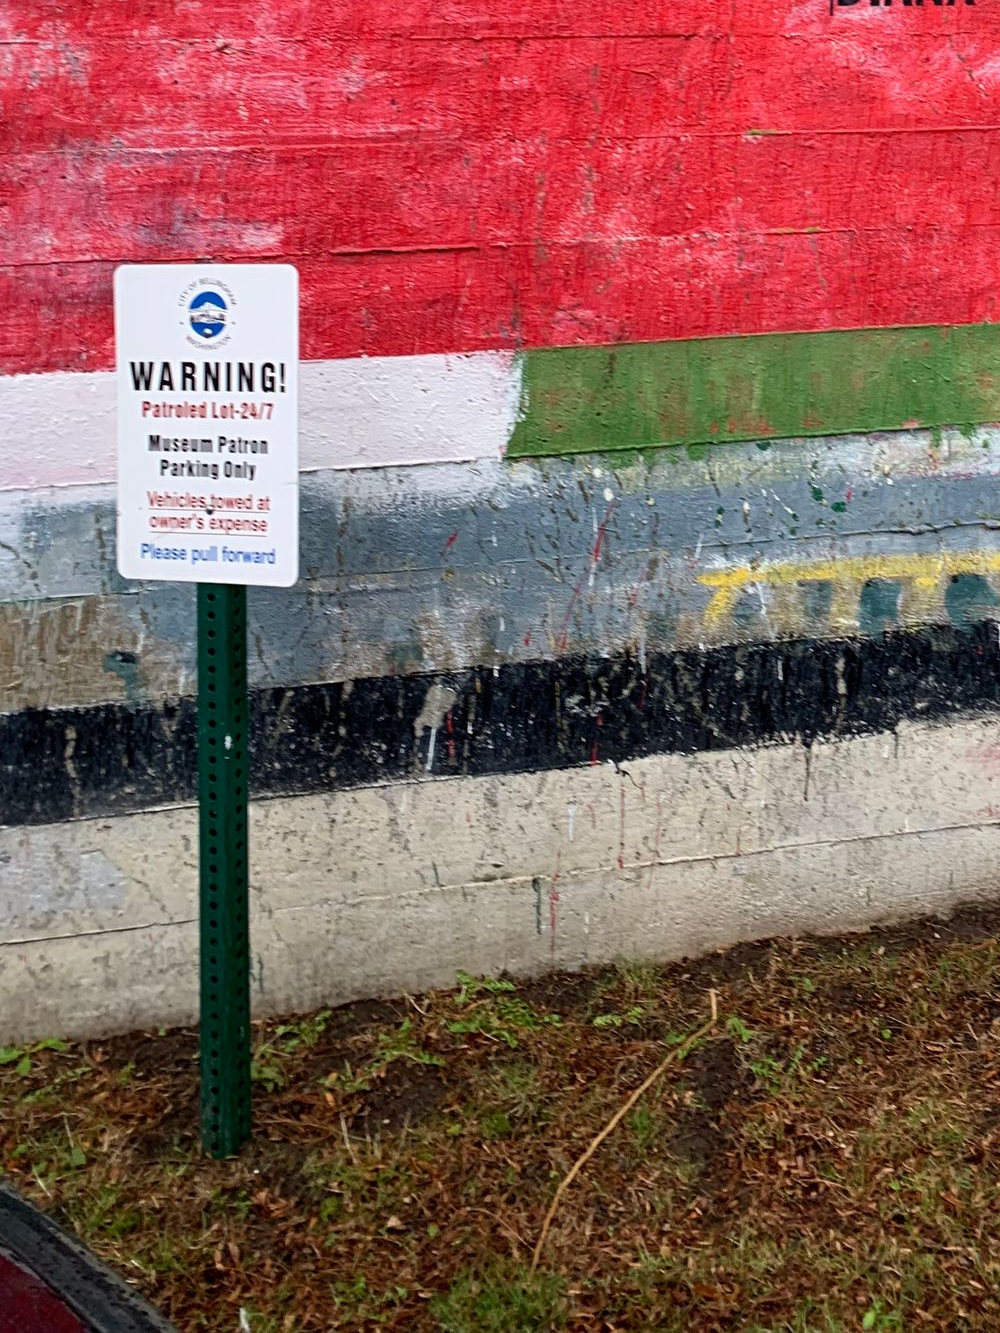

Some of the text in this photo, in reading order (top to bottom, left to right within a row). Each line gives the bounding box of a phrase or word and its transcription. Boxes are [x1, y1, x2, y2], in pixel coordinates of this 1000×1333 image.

[129, 361, 287, 393] WARNING!
[141, 400, 207, 418] Patroled
[148, 434, 269, 454] Museum Patron
[160, 459, 257, 481] Parking Only
[146, 491, 271, 511] Vehicles towed at
[148, 513, 268, 535] owner's expense
[140, 543, 276, 565] Please pull forward
